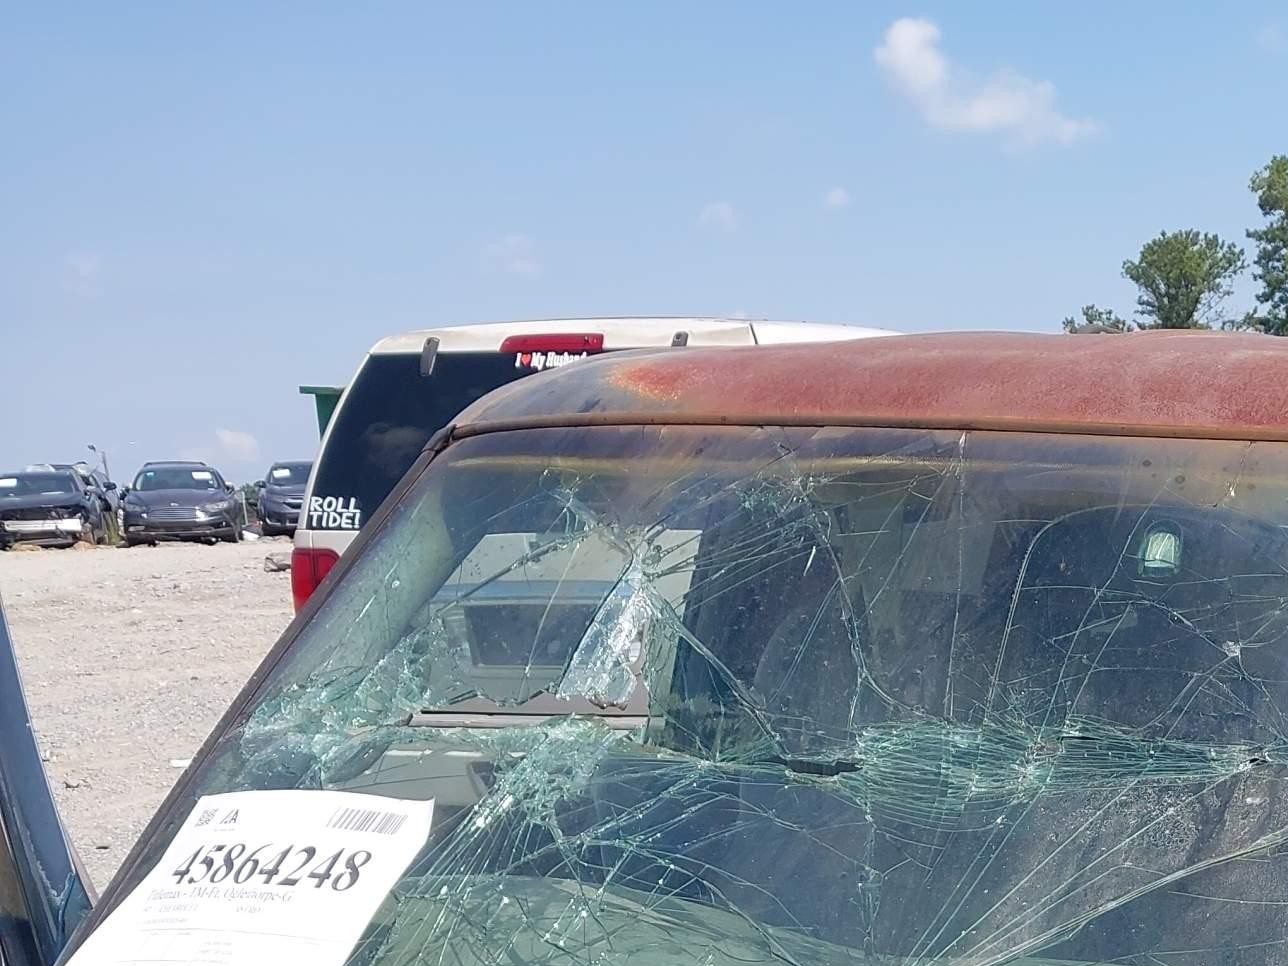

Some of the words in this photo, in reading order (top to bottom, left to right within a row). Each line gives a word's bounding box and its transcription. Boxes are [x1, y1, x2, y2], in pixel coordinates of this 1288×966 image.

[515, 352, 522, 367] I
[531, 352, 546, 370] My
[310, 496, 361, 512] ROLL
[310, 511, 361, 529] TIDE!
[172, 843, 372, 891] 45864248
